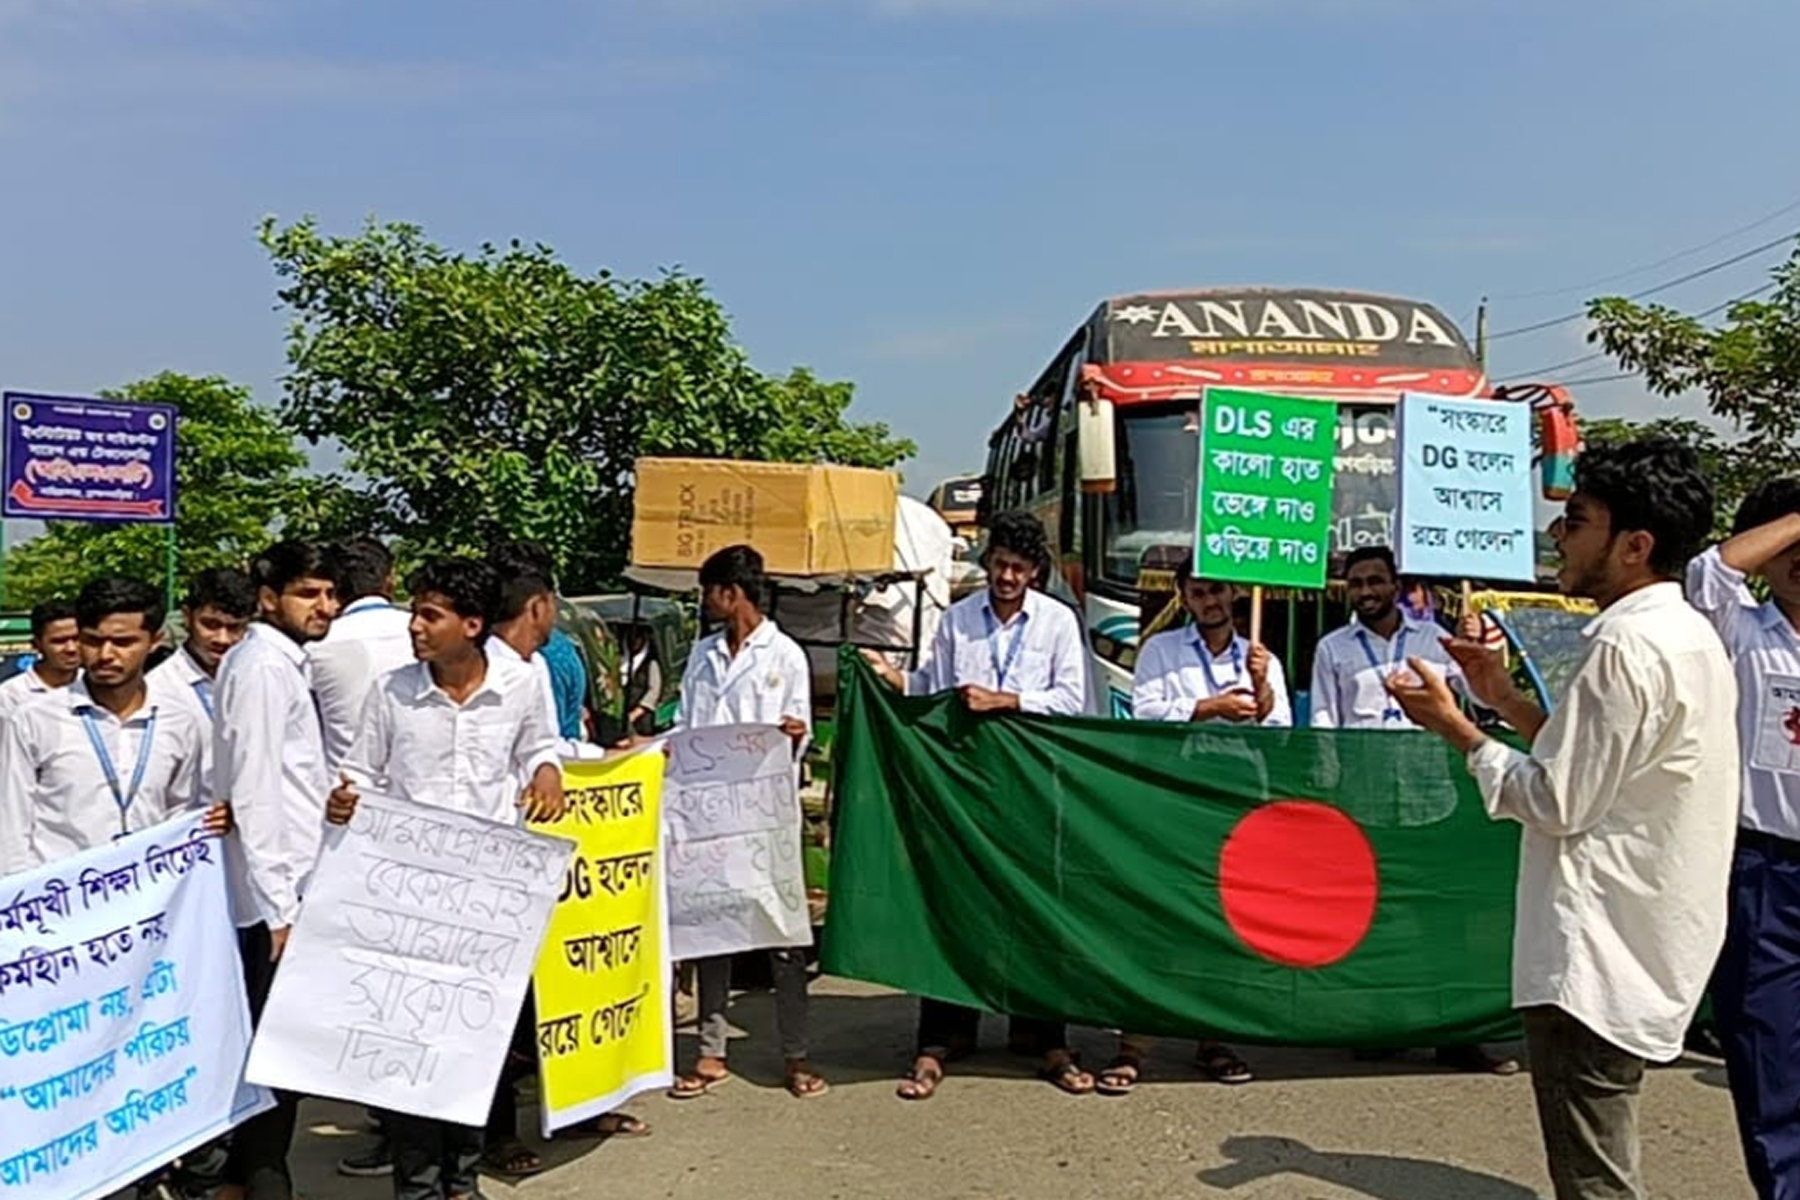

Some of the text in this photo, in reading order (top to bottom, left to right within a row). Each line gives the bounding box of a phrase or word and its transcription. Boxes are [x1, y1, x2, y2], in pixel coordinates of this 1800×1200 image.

[1152, 299, 1457, 348] ANANDA
[1215, 405, 1272, 438] DLS
[1281, 416, 1318, 441] এর
[1210, 449, 1274, 479] কালো
[1279, 456, 1323, 485] হাত
[1422, 444, 1459, 469] DG
[1466, 450, 1514, 473] হলেন
[1274, 496, 1315, 523] দাও
[1433, 487, 1503, 511] আশ্বাসে
[1277, 538, 1318, 564] দাও
[1411, 525, 1448, 546] রয়ে
[0, 878, 70, 933] র্মমূখী
[78, 862, 141, 909] শিক্ষা
[80, 926, 133, 966] হতে
[564, 924, 642, 973] আশ্বাসে
[123, 1015, 191, 1067] পরিচয়
